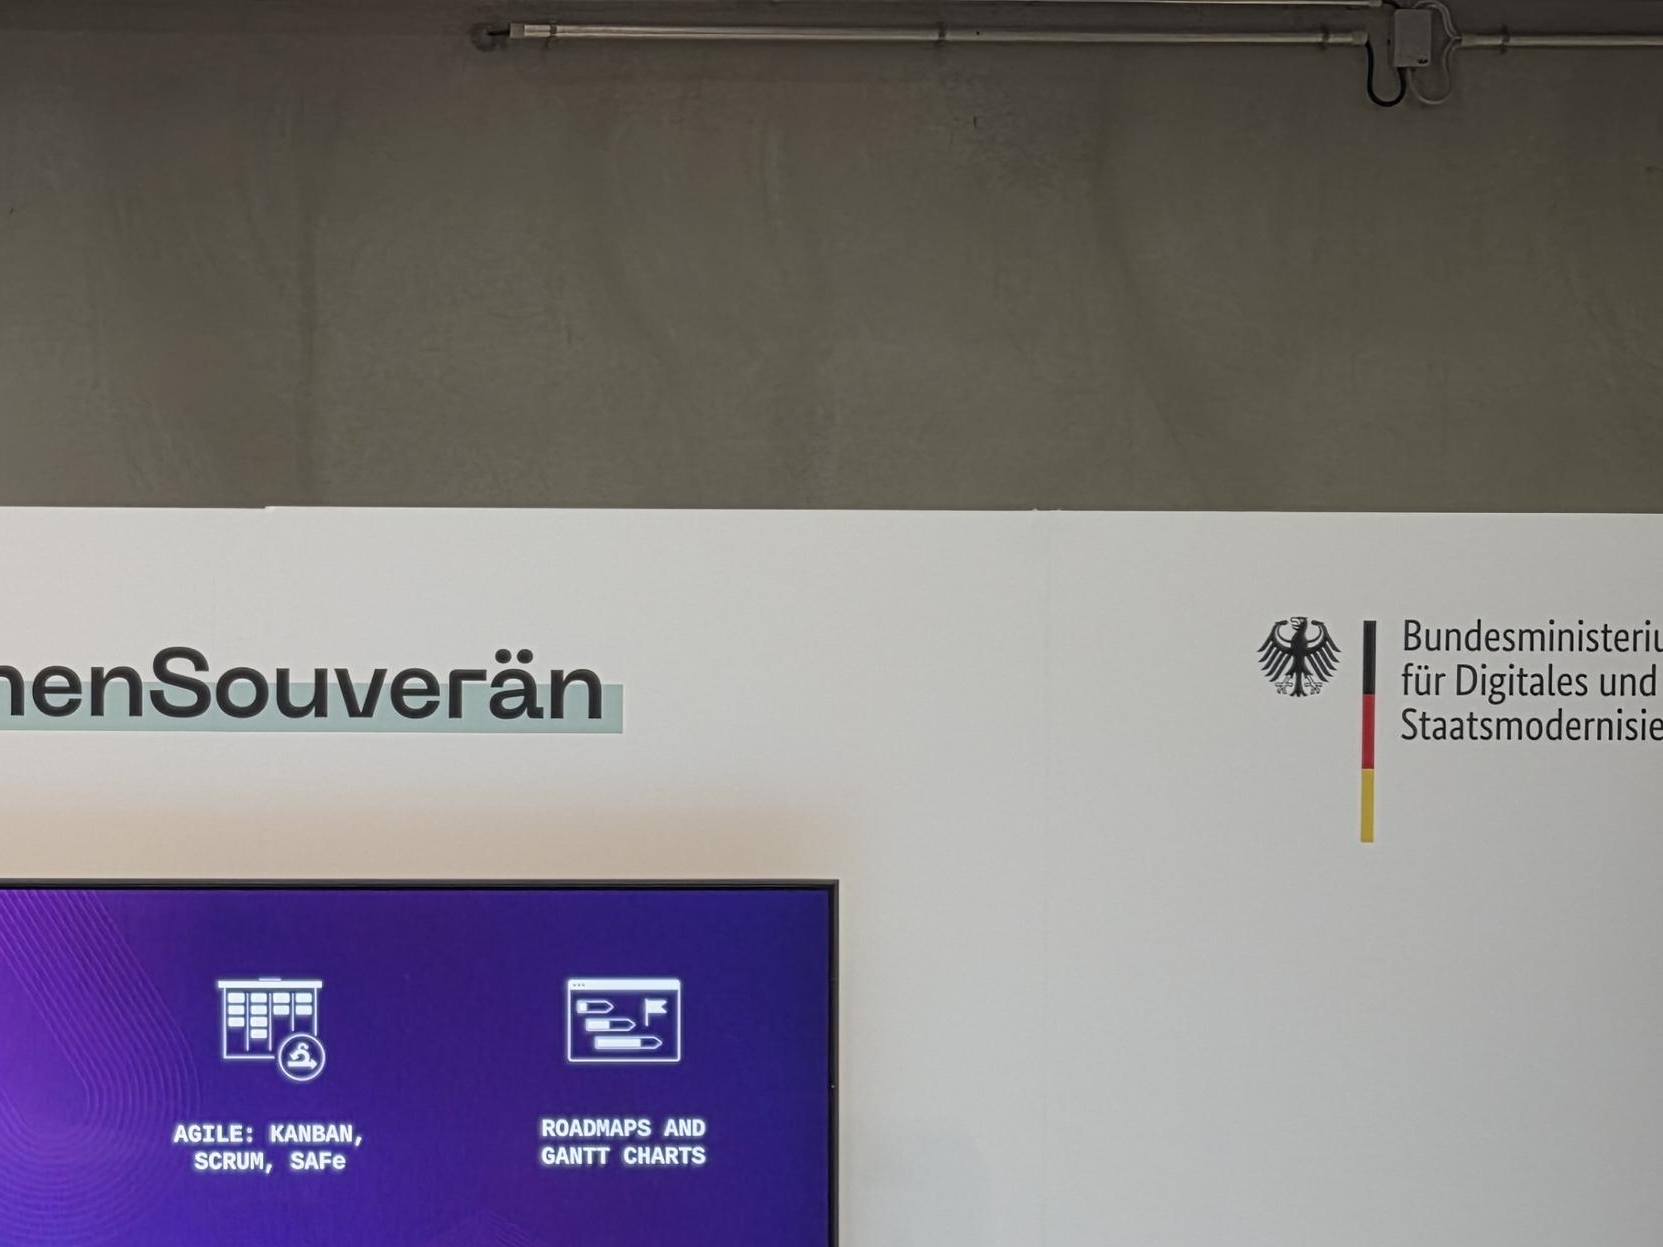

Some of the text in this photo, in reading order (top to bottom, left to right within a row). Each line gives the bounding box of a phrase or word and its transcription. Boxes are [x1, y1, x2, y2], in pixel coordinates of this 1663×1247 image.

[1401, 662, 1657, 706] für Digitales und
[1401, 707, 1663, 741] Staatsmodernisie
[172, 1123, 364, 1147] AGILE: KANBAN,
[541, 1118, 706, 1137] ROADMAPS AND
[193, 1150, 347, 1174] SCRUM, SAFe
[540, 1145, 707, 1165] GANTT CHARTS
